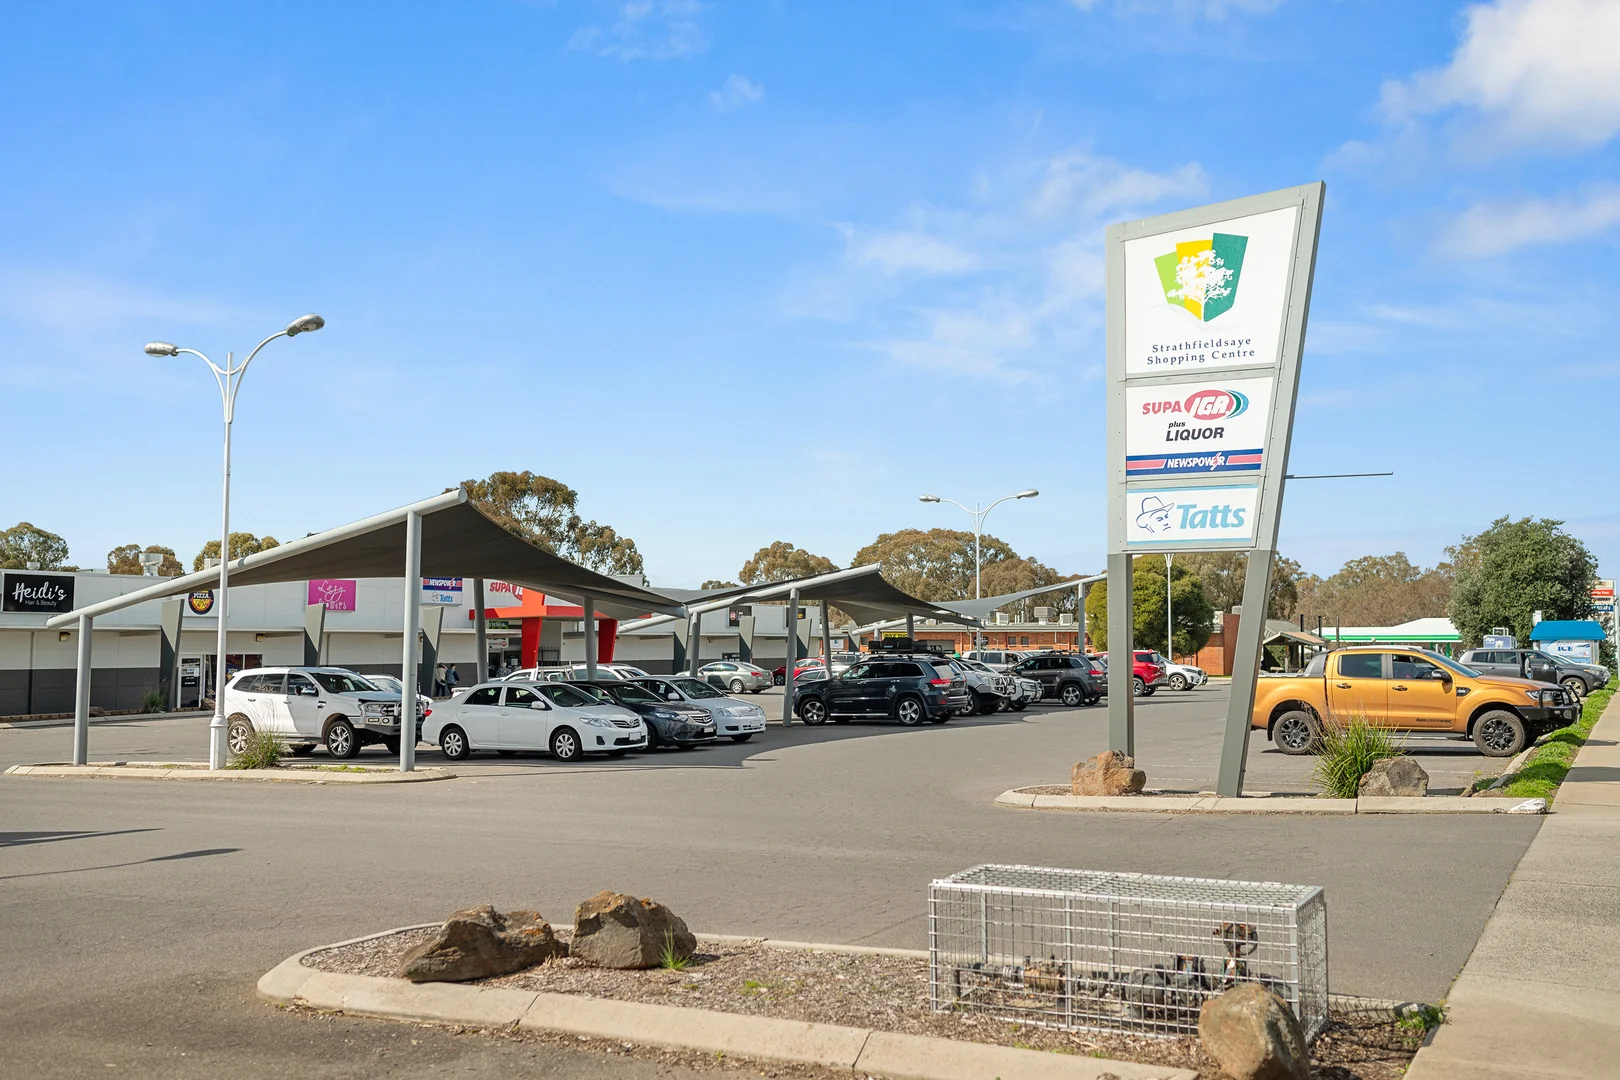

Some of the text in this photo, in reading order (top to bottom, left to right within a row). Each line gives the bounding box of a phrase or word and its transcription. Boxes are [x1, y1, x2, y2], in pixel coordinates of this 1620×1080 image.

[1152, 338, 1251, 353] Strathfieldsaye
[1147, 349, 1255, 365] Shopping Centre
[1142, 394, 1231, 417] SUPA IGA
[1168, 420, 1186, 429] plus
[1165, 427, 1225, 442] LIQUOR
[1167, 453, 1226, 470] NEWSPOWER
[1176, 504, 1246, 529] Tatts
[12, 581, 67, 603] Heidi's
[489, 582, 511, 592] SUPA
[439, 594, 454, 602] Tatts
